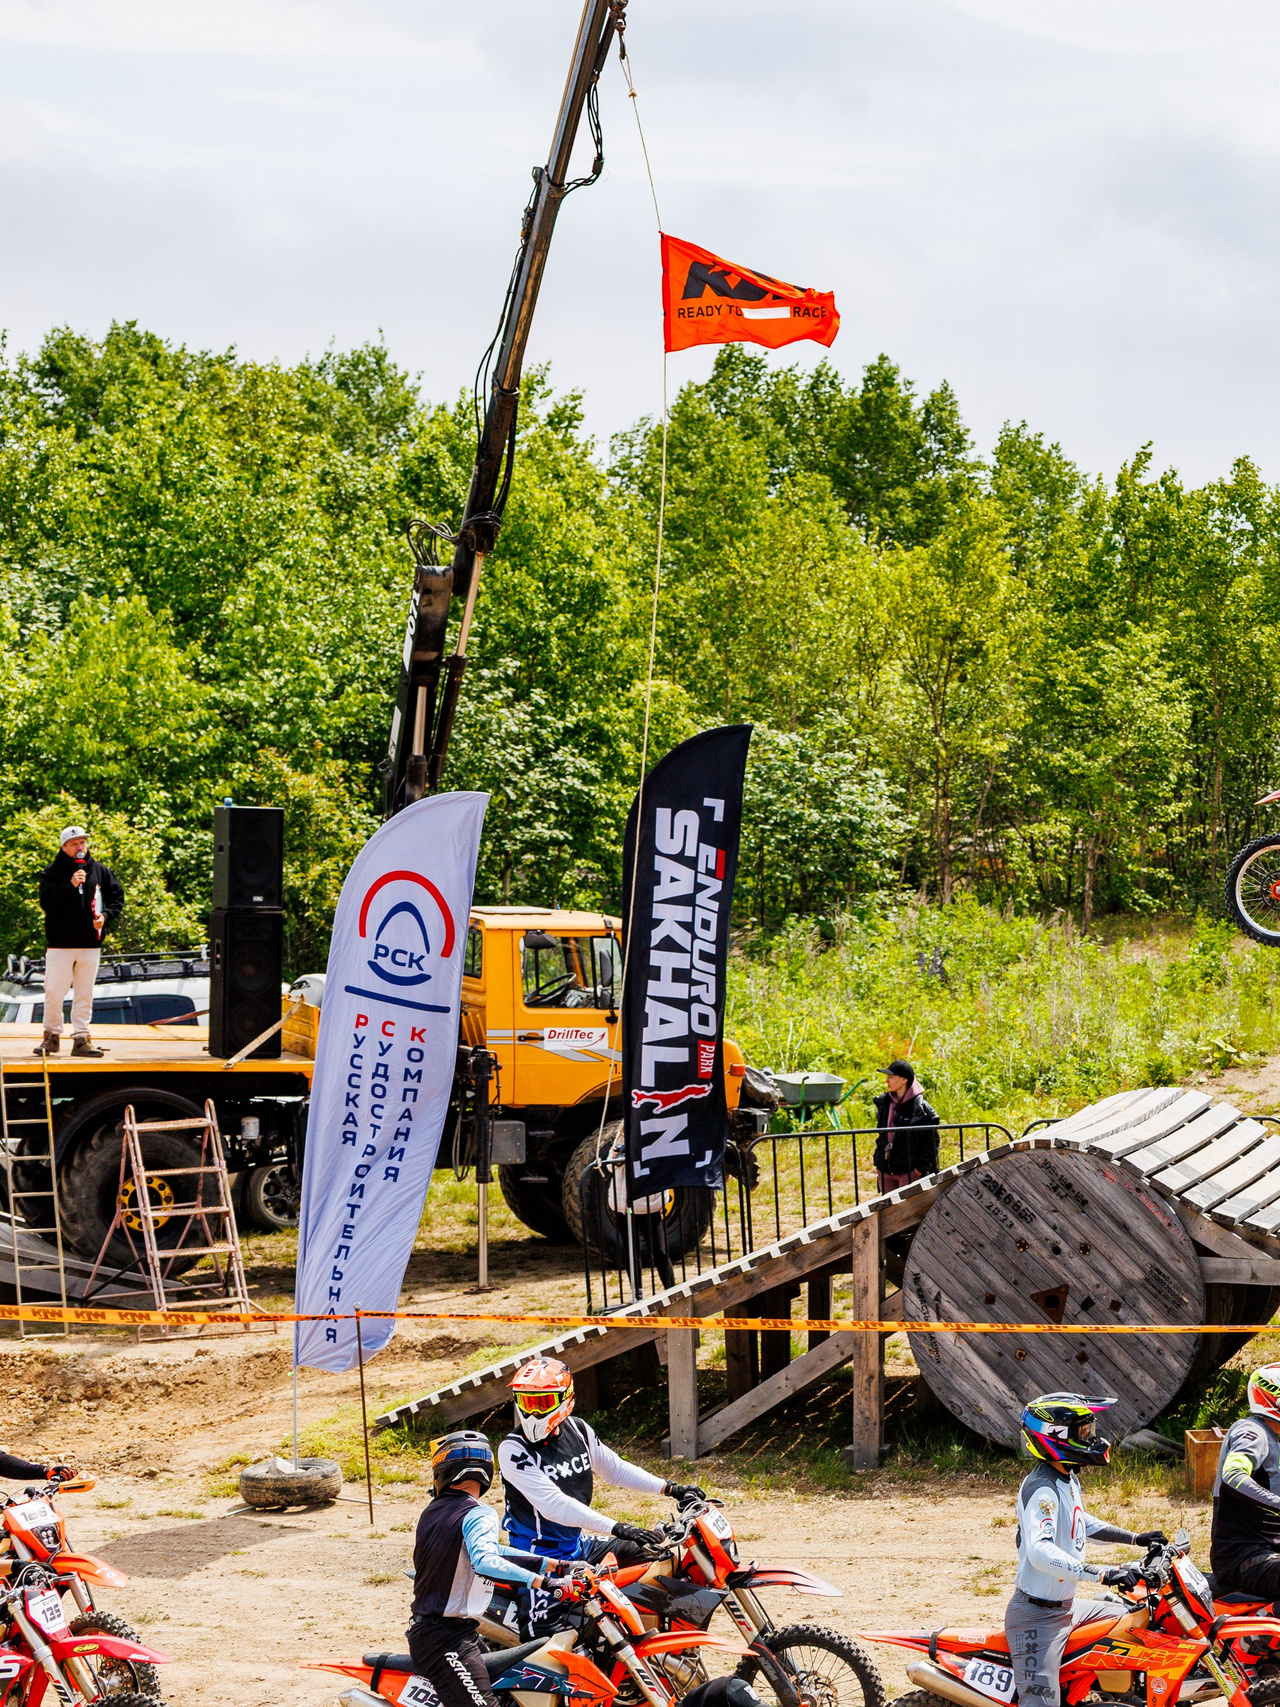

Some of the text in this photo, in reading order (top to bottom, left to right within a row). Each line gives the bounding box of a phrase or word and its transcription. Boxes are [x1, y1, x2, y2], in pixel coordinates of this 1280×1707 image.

[678, 304, 827, 319] READY TO RACE
[373, 943, 426, 972] РСК
[690, 843, 726, 1073] ENDURO PARK
[548, 1030, 594, 1039] DrillTec
[342, 1013, 369, 1146] РУССКАЯ
[382, 1026, 427, 1182] КОМПАНИЯ
[970, 1662, 1014, 1693] 189
